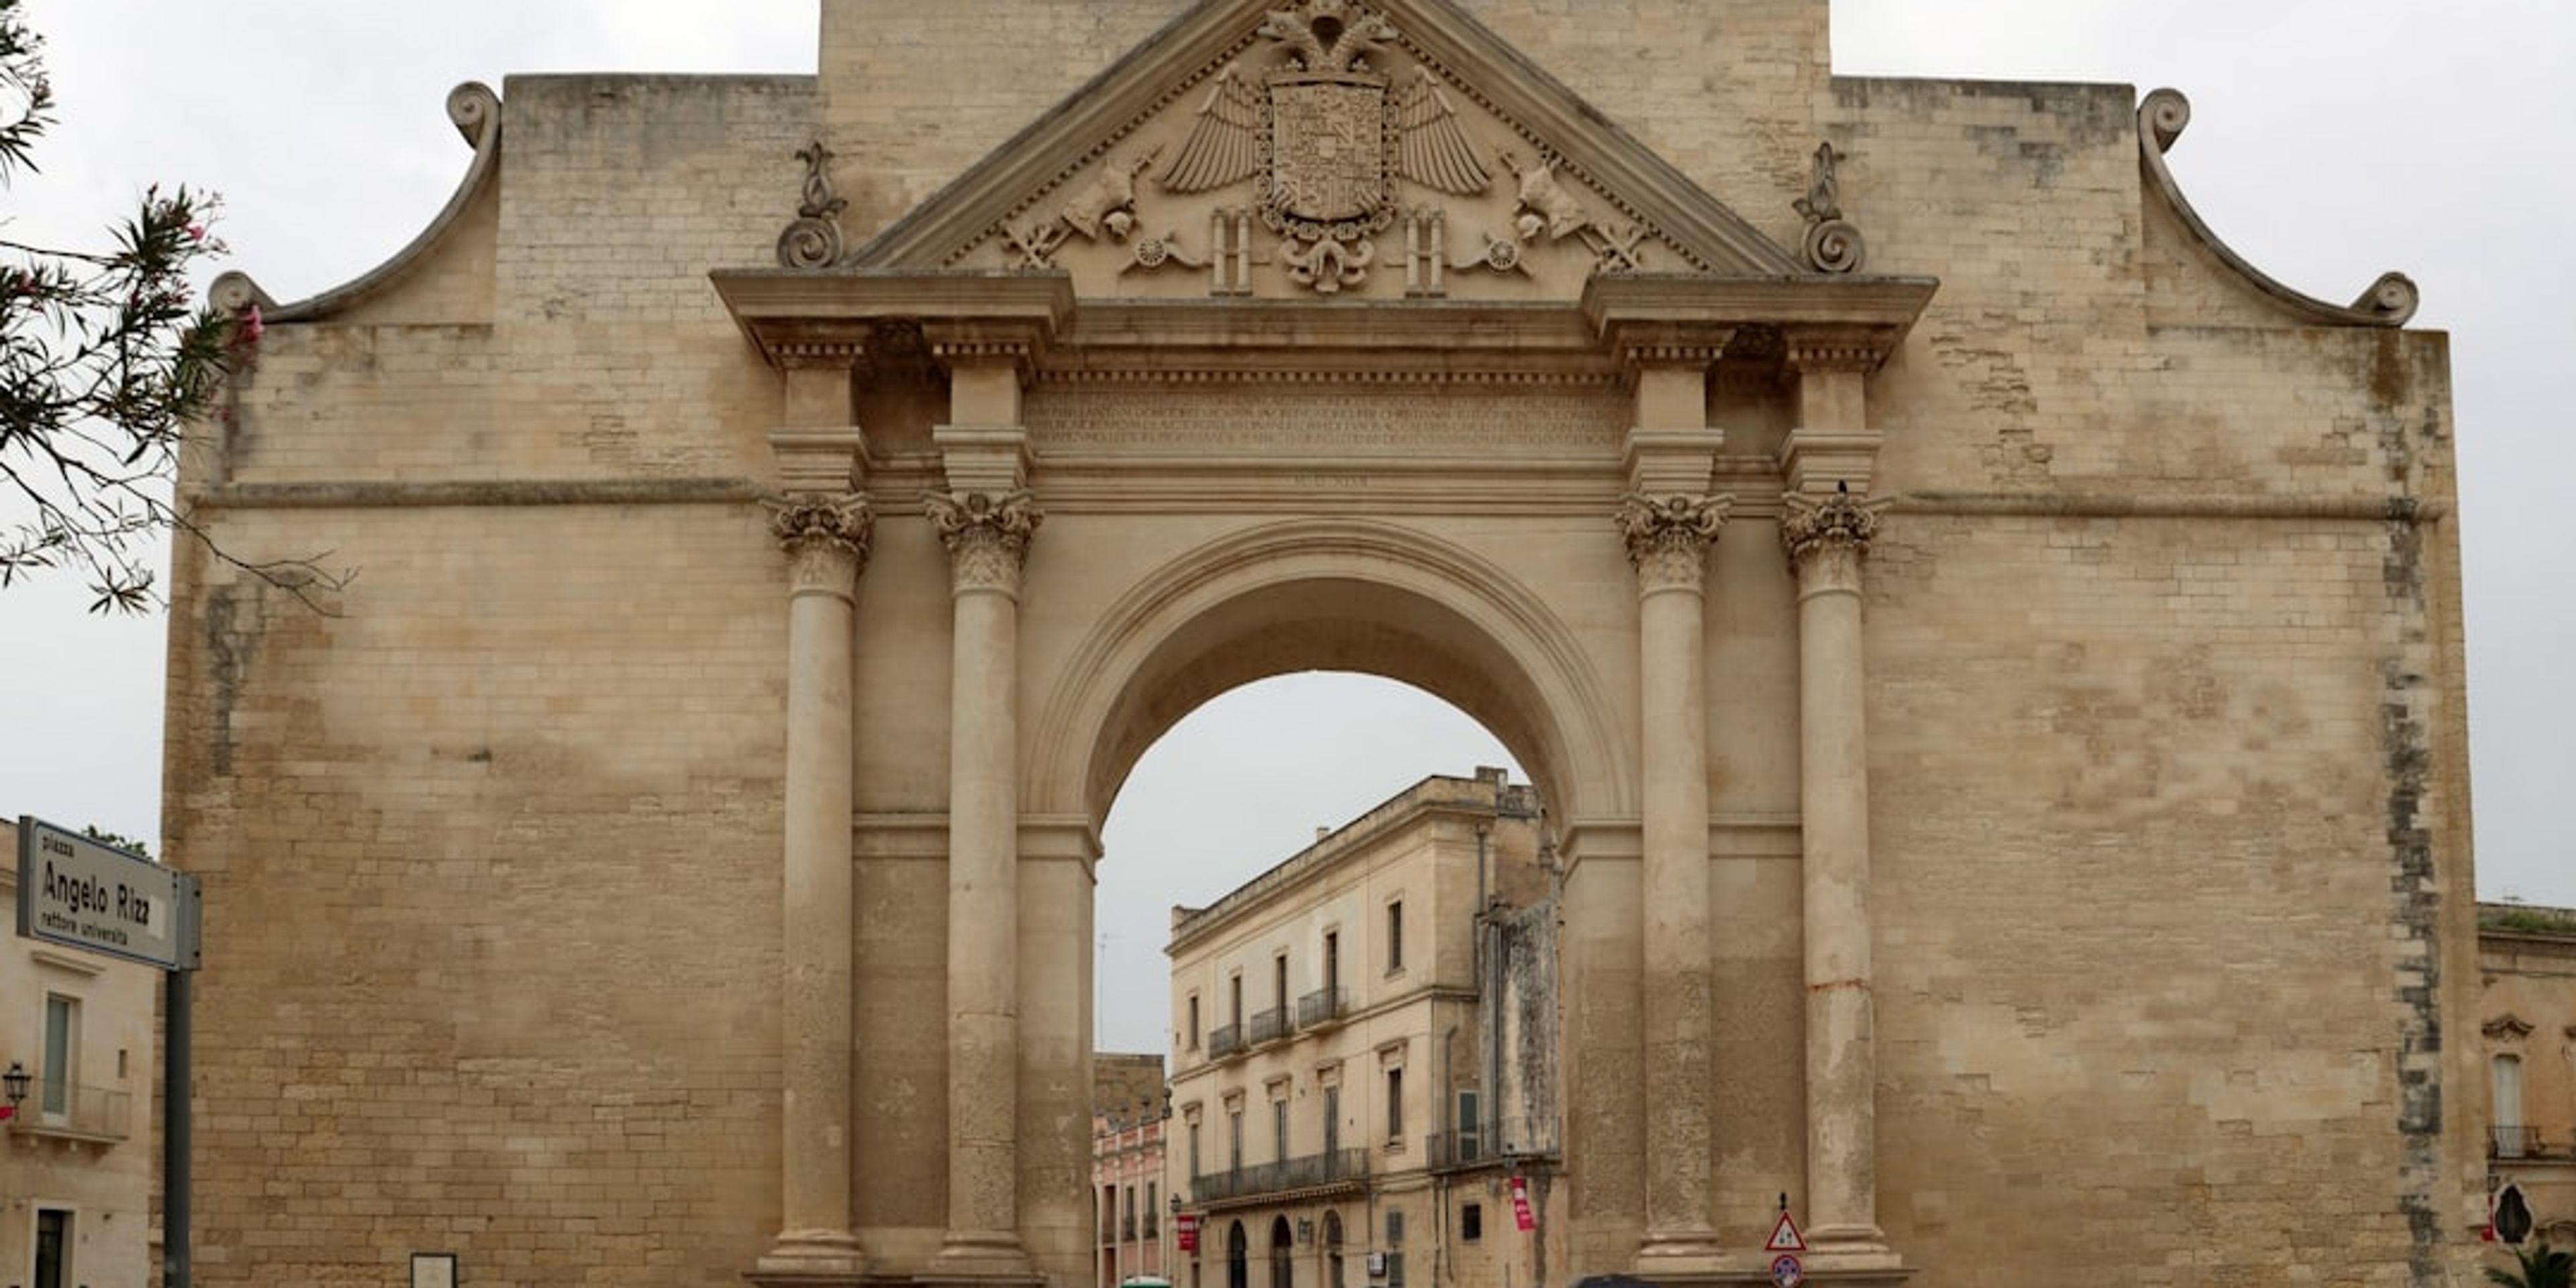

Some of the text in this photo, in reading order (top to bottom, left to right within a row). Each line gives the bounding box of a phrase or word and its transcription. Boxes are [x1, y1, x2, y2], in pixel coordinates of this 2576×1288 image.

[42, 833, 74, 857] piazza
[42, 861, 150, 925] Angelo Rizz
[41, 911, 77, 933] rettore
